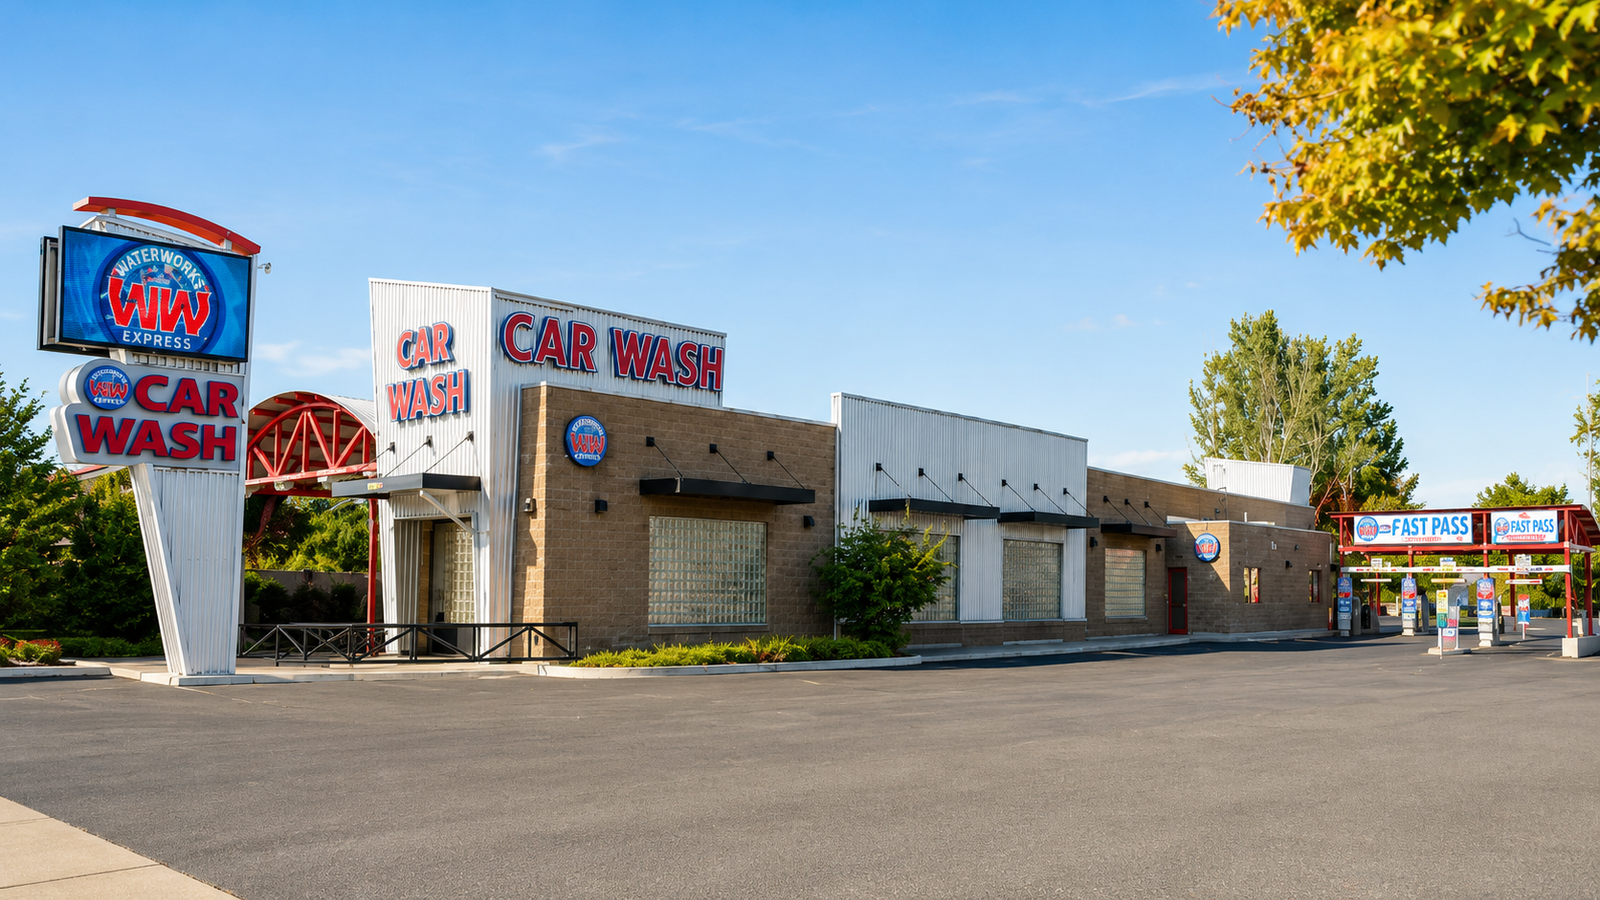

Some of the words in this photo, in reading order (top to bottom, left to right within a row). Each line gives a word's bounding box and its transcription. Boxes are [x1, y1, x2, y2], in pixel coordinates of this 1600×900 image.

[123, 330, 191, 349] EXPRESS
[397, 321, 454, 370] CAR
[501, 311, 598, 373] CAR
[609, 326, 724, 392] WASH
[134, 374, 239, 418] CAR
[386, 368, 468, 422] WASH
[75, 414, 237, 461] WASH
[1392, 517, 1428, 536] FAST
[1432, 515, 1469, 536] PASS
[1511, 519, 1531, 533] FAST
[1532, 518, 1555, 533] PASS
